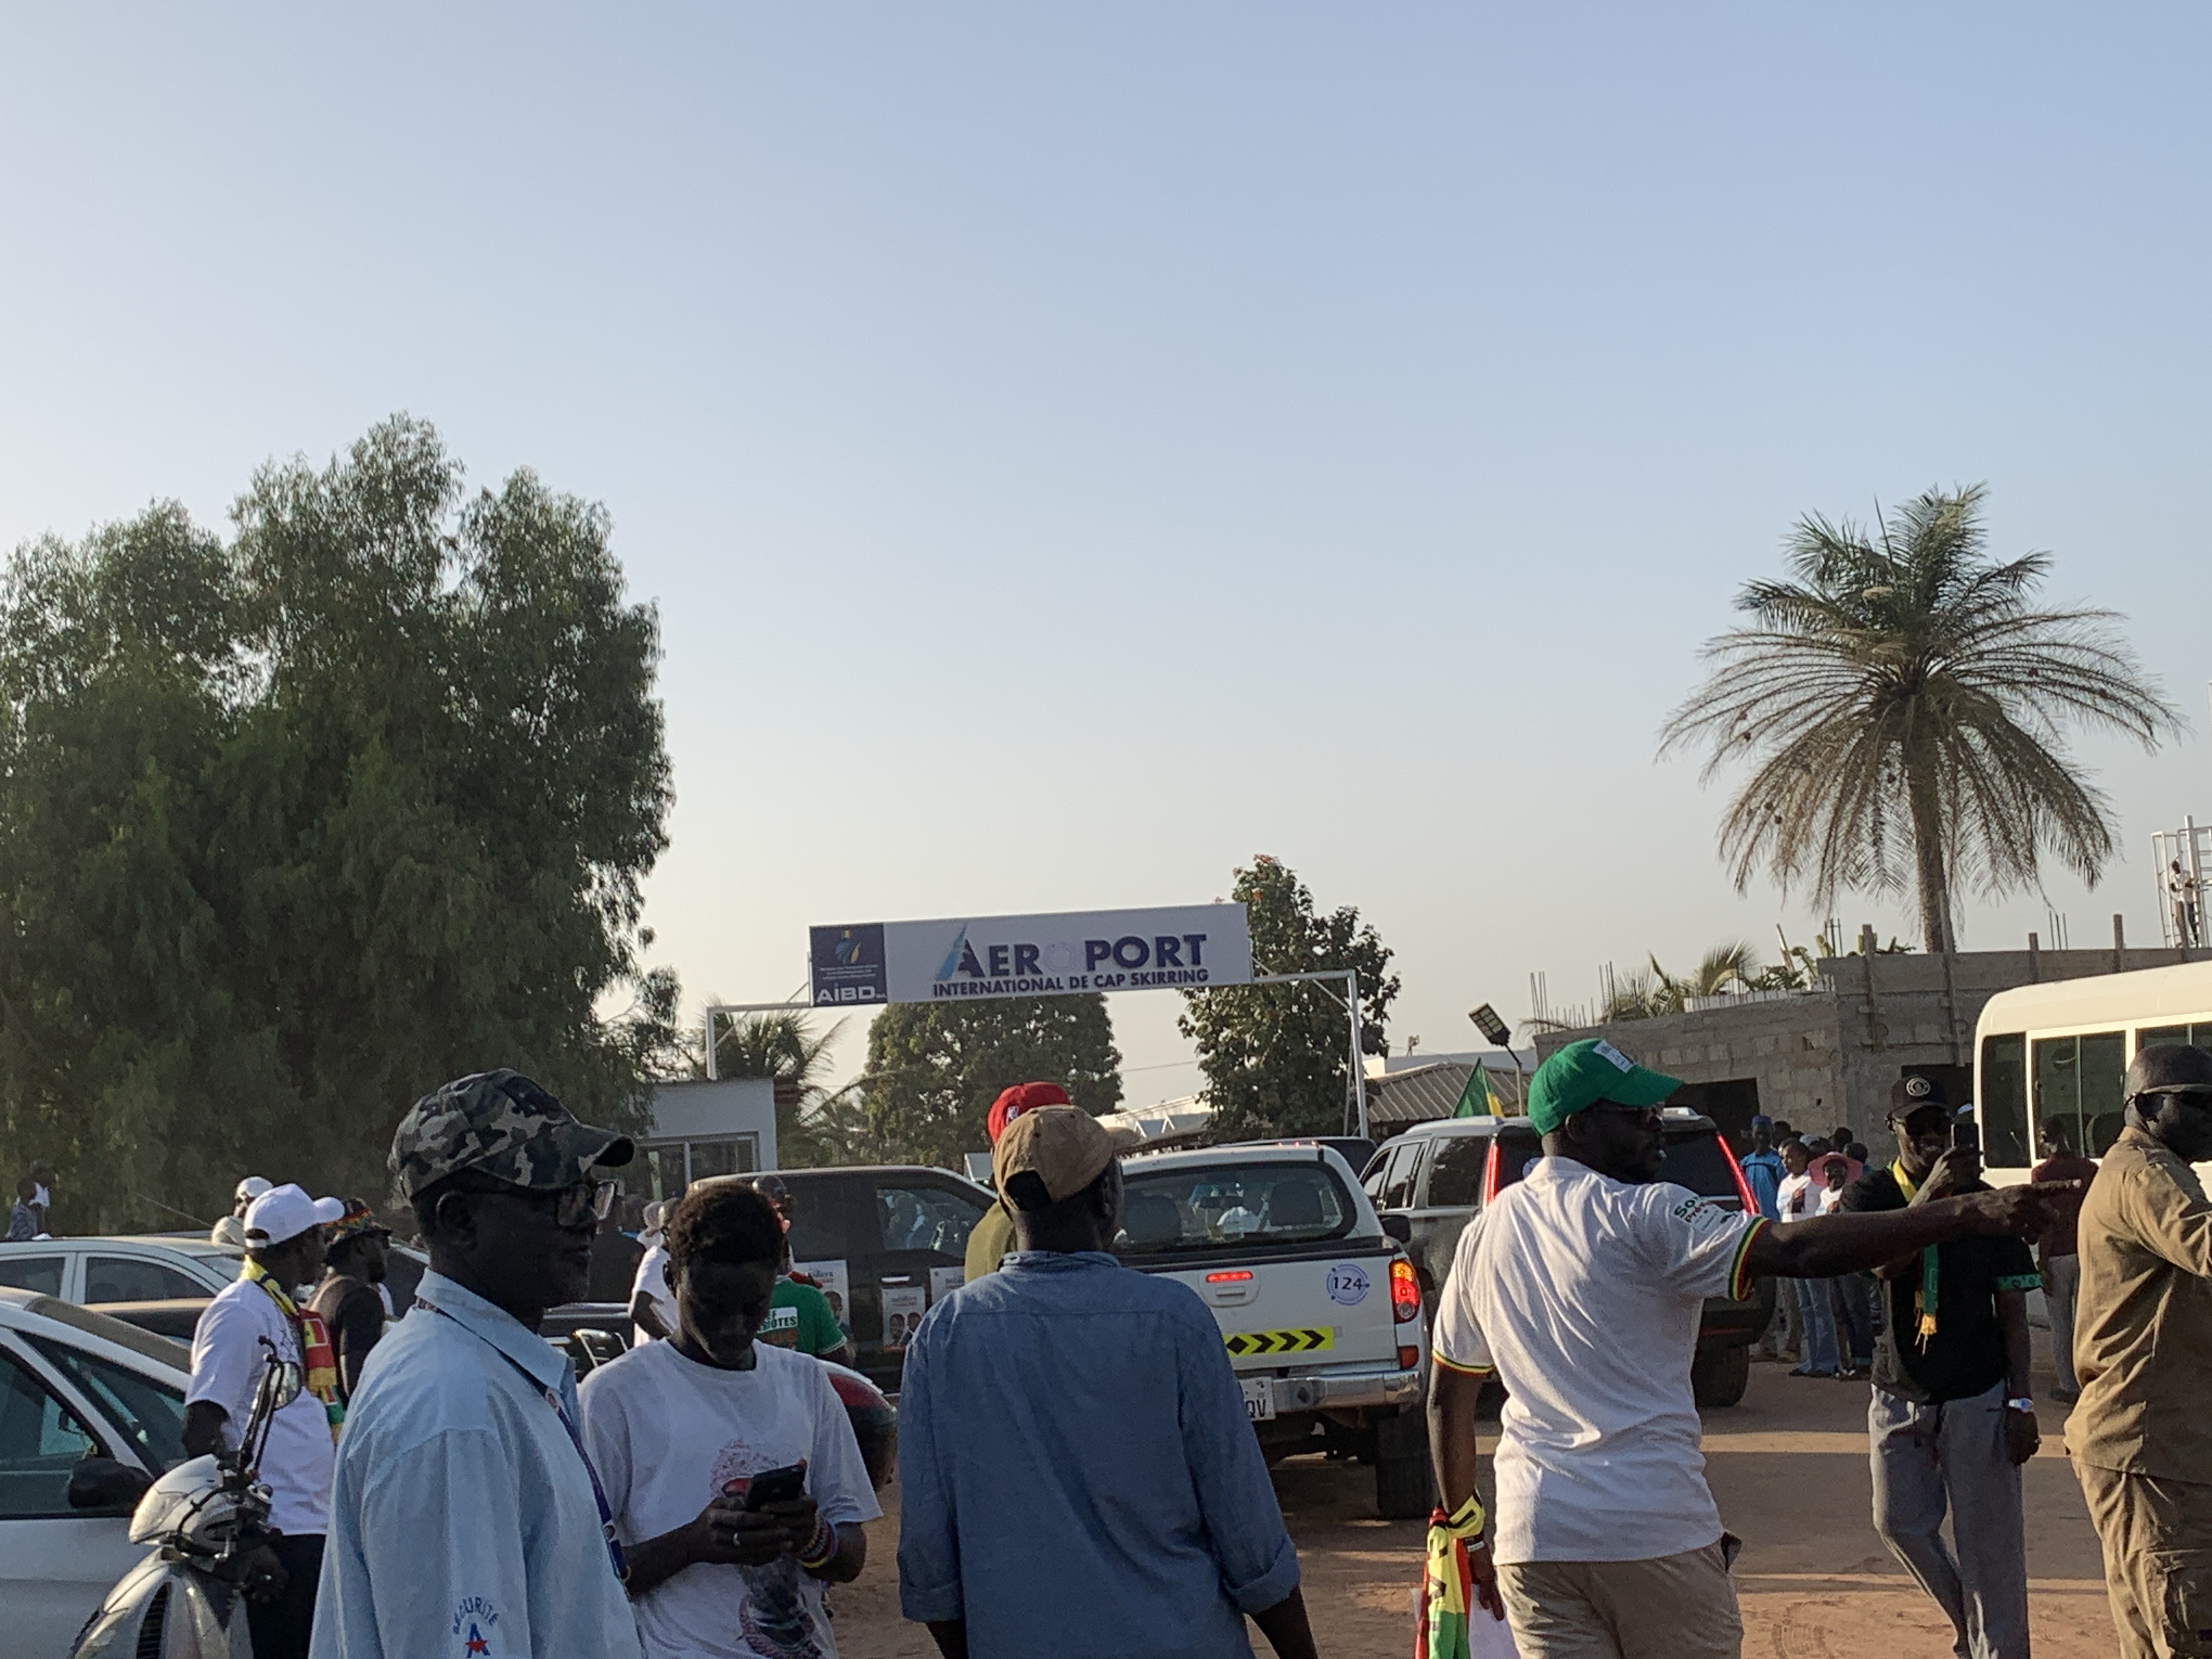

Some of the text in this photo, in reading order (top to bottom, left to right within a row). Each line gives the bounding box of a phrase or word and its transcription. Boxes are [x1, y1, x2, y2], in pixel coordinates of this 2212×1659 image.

[934, 968, 1209, 997] INTERNATIONAL DE CAP SKIRRING
[1334, 1276, 1363, 1291] 124
